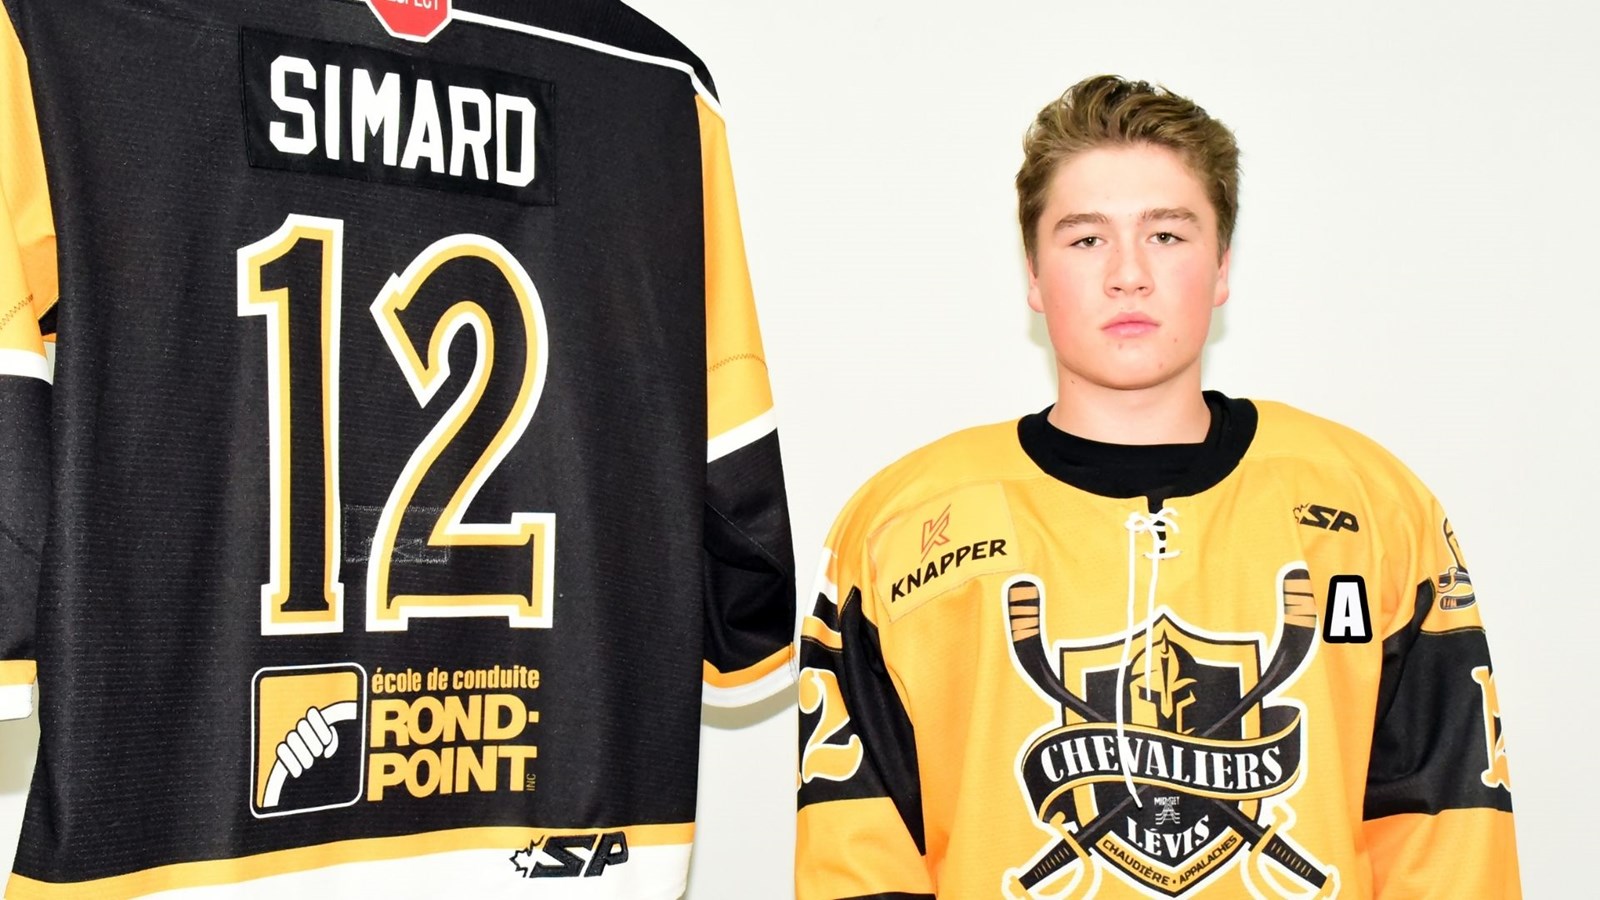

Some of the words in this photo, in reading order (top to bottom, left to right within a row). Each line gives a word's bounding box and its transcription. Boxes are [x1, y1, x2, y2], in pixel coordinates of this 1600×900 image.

[269, 55, 537, 187] SIMARD
[236, 213, 556, 635] 12
[891, 539, 1008, 603] KNAPPER
[1325, 577, 1370, 641] A
[371, 667, 422, 694] école
[427, 667, 448, 691] de
[452, 665, 540, 690] conduite
[367, 745, 537, 801] POINT
[526, 773, 537, 791] INC
[1041, 735, 1283, 790] CHEVALIERS
[1102, 839, 1171, 886] CHAUDIÈRE
[1179, 835, 1238, 885] APPALACHES
[1126, 815, 1210, 858] LÉVIS
